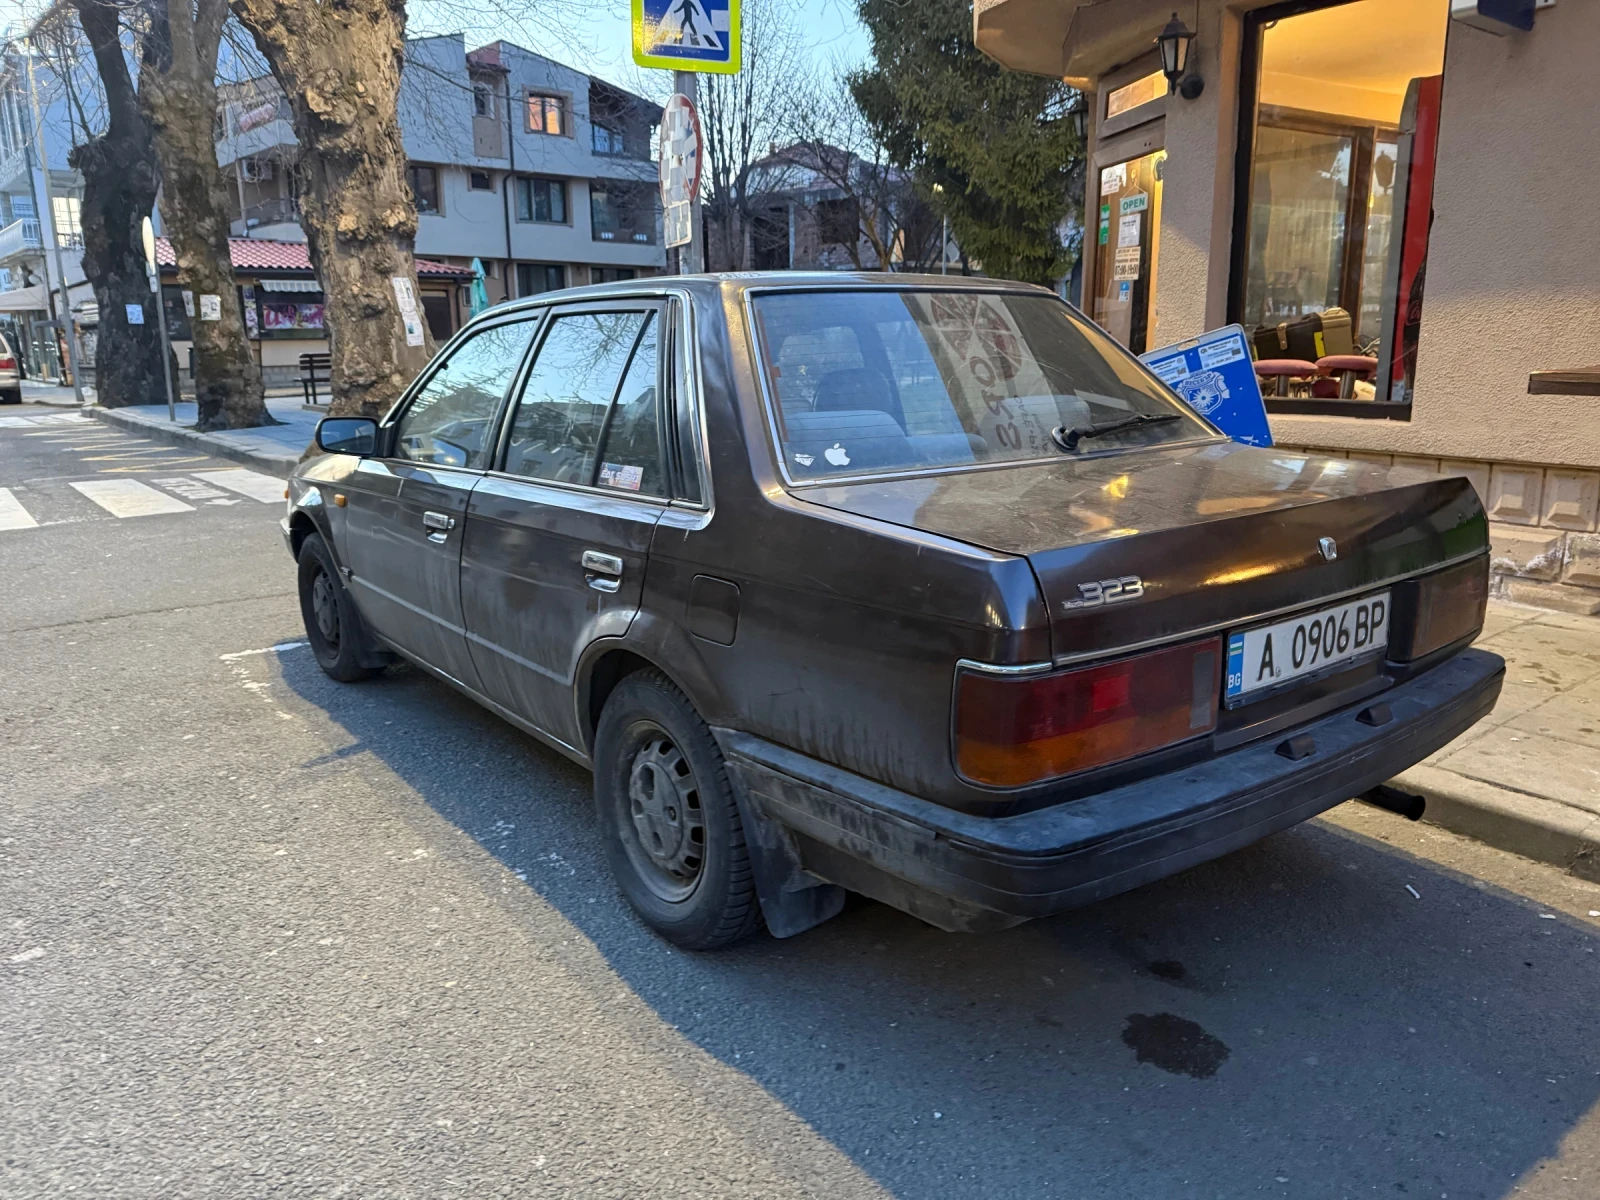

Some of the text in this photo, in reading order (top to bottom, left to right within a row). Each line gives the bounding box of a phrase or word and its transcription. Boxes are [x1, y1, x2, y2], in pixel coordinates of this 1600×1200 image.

[1122, 197, 1145, 211] OPEN
[1077, 574, 1144, 607] 323
[1256, 600, 1385, 682] A 0906 BP
[1228, 672, 1241, 689] BG
